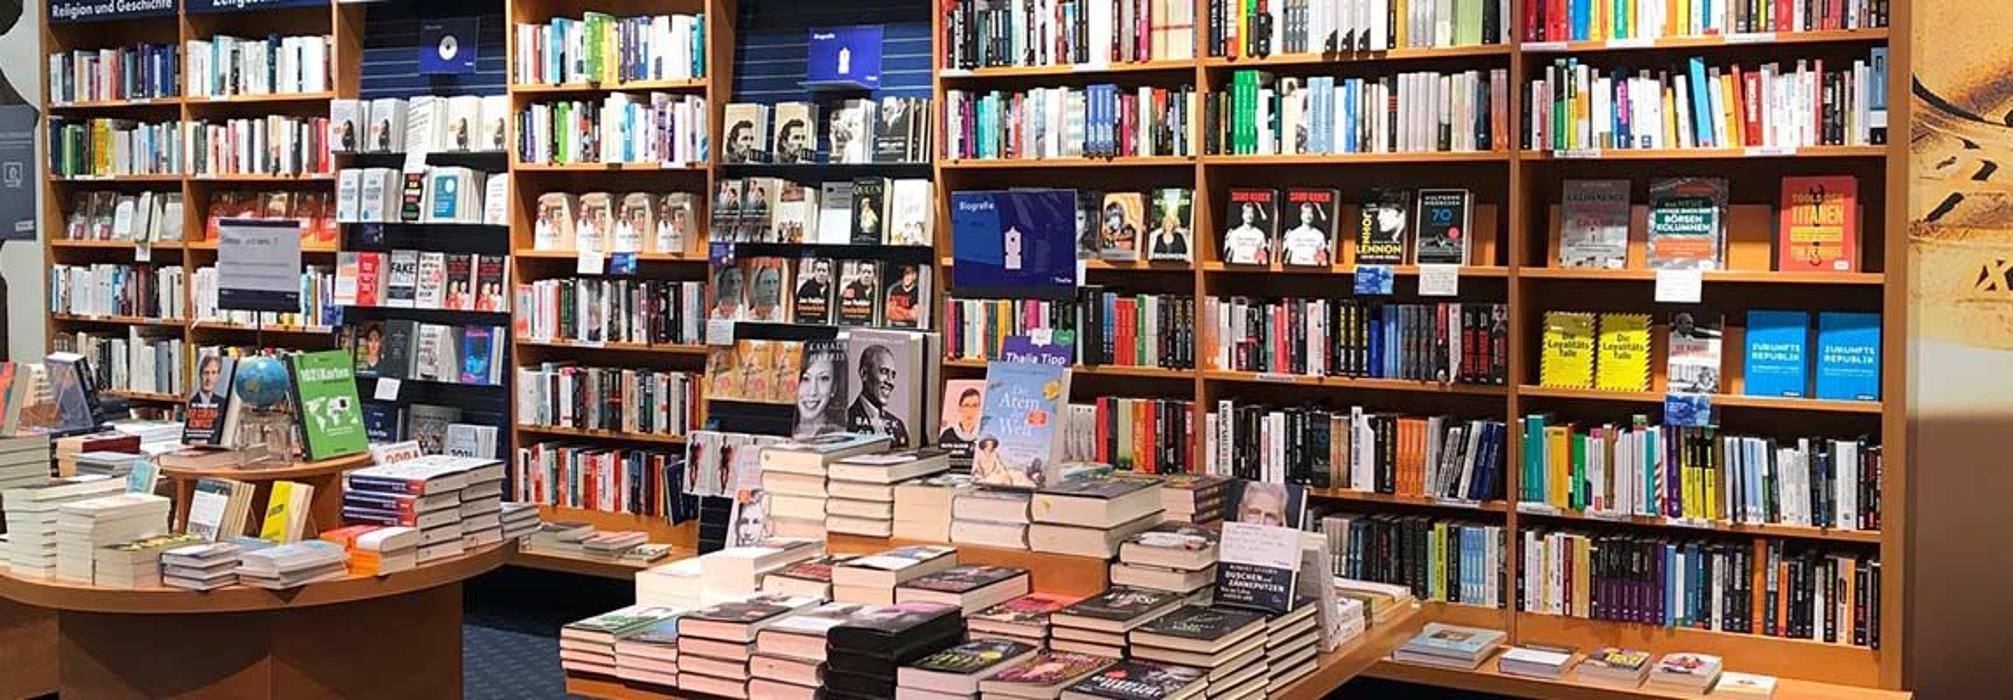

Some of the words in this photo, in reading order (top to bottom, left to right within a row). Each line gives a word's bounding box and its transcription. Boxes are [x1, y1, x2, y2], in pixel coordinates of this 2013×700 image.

[52, 3, 93, 19] Religion
[95, 4, 114, 15] und
[117, 0, 173, 13] Geschichte
[959, 201, 994, 212] Biografie
[1432, 208, 1452, 221] 70
[1791, 205, 1844, 224] TITANEN
[1356, 244, 1401, 255] LENNON
[391, 262, 416, 274] FAKE
[1562, 332, 1575, 341] Die
[1617, 334, 1630, 342] Die
[809, 342, 848, 351] KAMALA
[1548, 339, 1590, 350] Loyalitäts
[1603, 342, 1644, 352] Loyalitäts
[1752, 342, 1800, 351] ZUKUNFTS
[1824, 345, 1875, 354] ZUKUNFTS
[1752, 351, 1800, 360] REPUBLIK
[1824, 354, 1874, 364] REPUBLIK
[999, 392, 1040, 410] Atem
[1000, 416, 1032, 436] Welt
[1225, 570, 1263, 580] DUSCHEN
[1228, 579, 1284, 592] ZÄHNEPUTZEN
